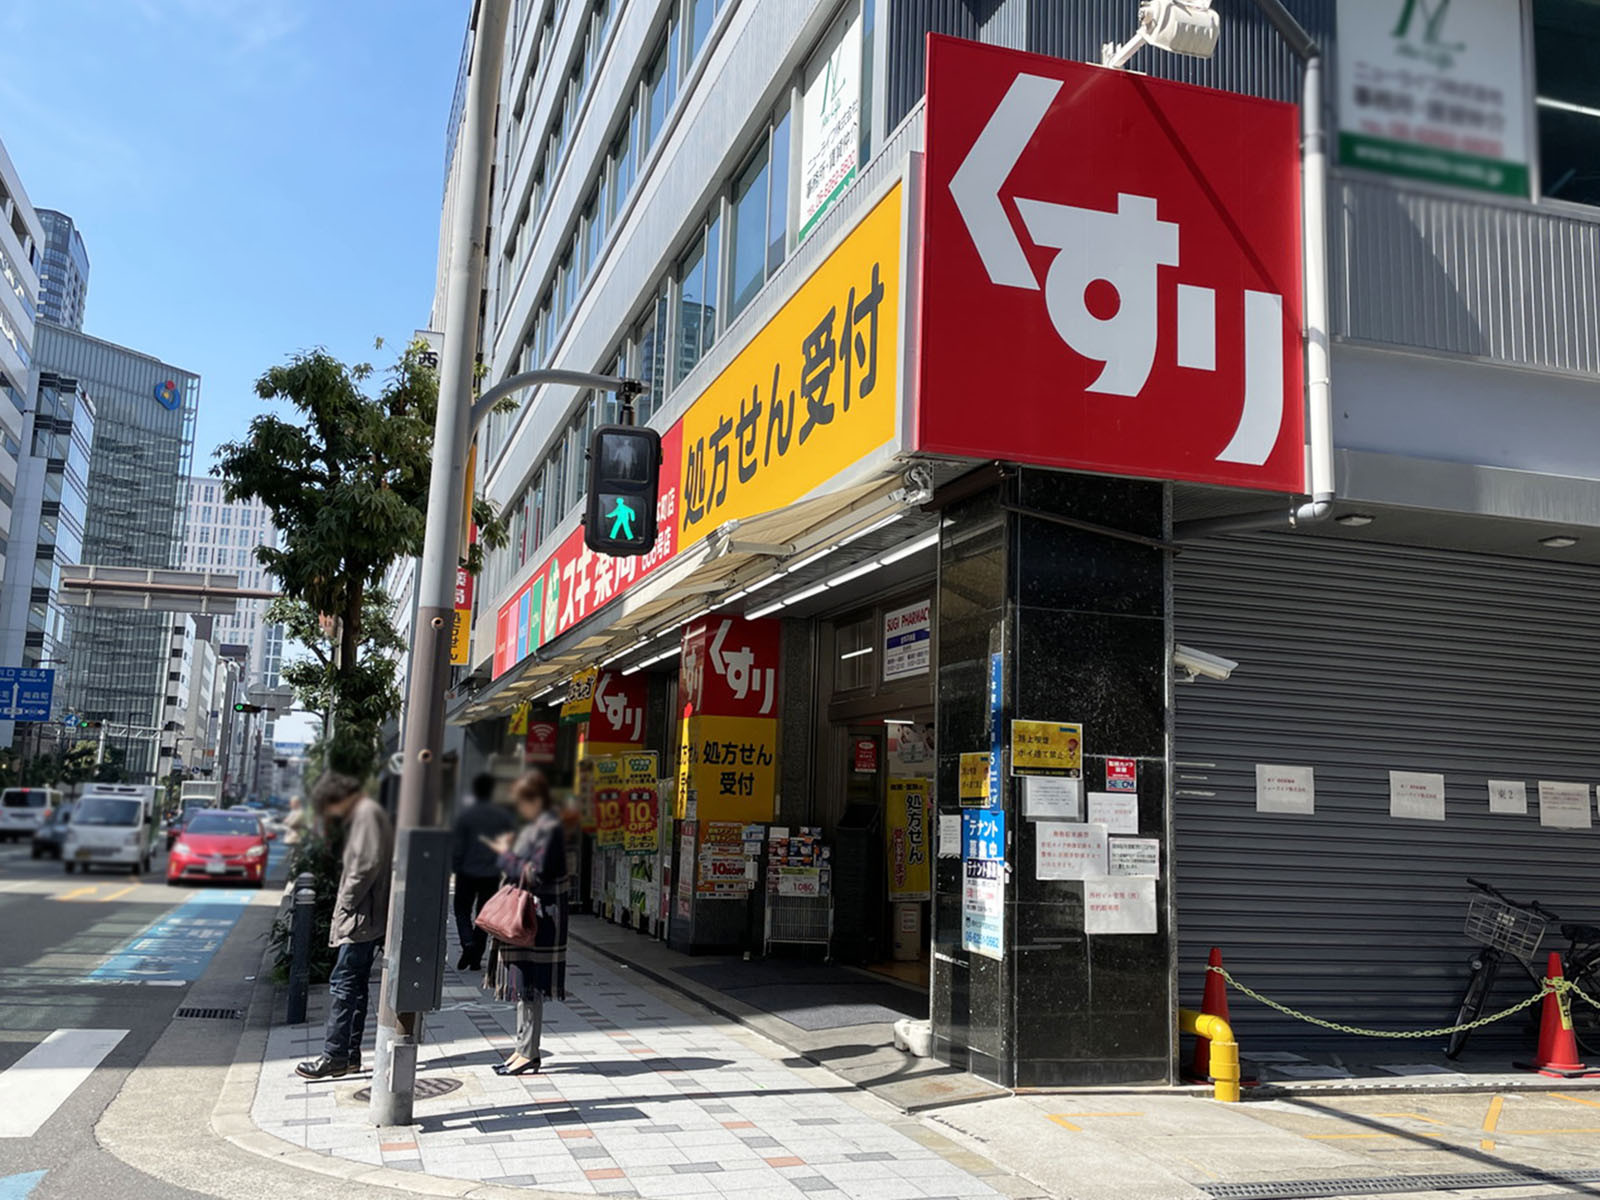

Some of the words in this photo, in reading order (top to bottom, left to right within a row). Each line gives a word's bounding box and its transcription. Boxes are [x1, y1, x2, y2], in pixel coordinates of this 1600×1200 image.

[948, 72, 1284, 466] くすり
[683, 262, 885, 532] 処方せん受付
[709, 619, 775, 714] くすり
[595, 673, 643, 741] くすり
[703, 741, 773, 766] 処方せん
[719, 771, 755, 797] 受付
[626, 801, 651, 822] 10
[904, 793, 924, 865] 処方せん
[968, 819, 999, 838] テナント
